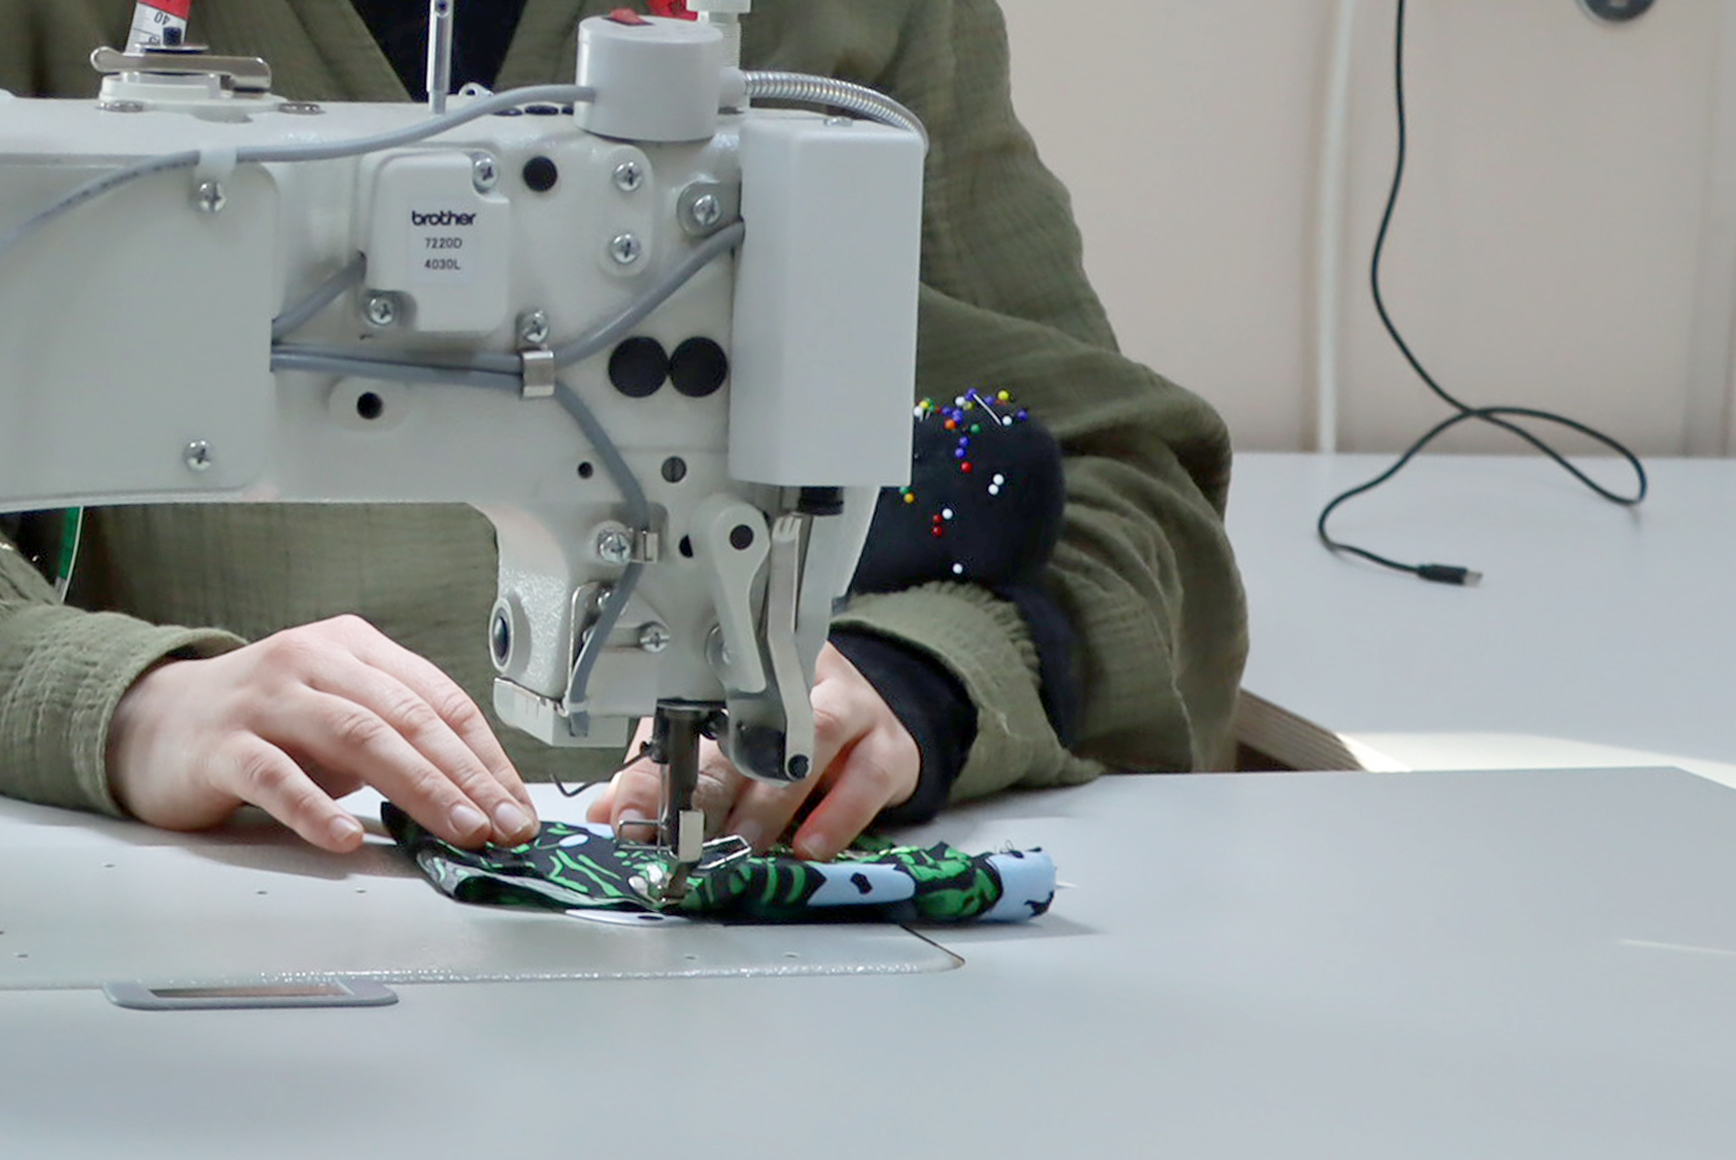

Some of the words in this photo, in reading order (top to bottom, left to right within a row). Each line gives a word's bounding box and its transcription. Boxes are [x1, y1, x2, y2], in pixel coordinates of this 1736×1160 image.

[154, 11, 170, 26] 40
[411, 210, 477, 226] brother
[425, 237, 463, 249] 7220D
[424, 259, 461, 270] 4030L
